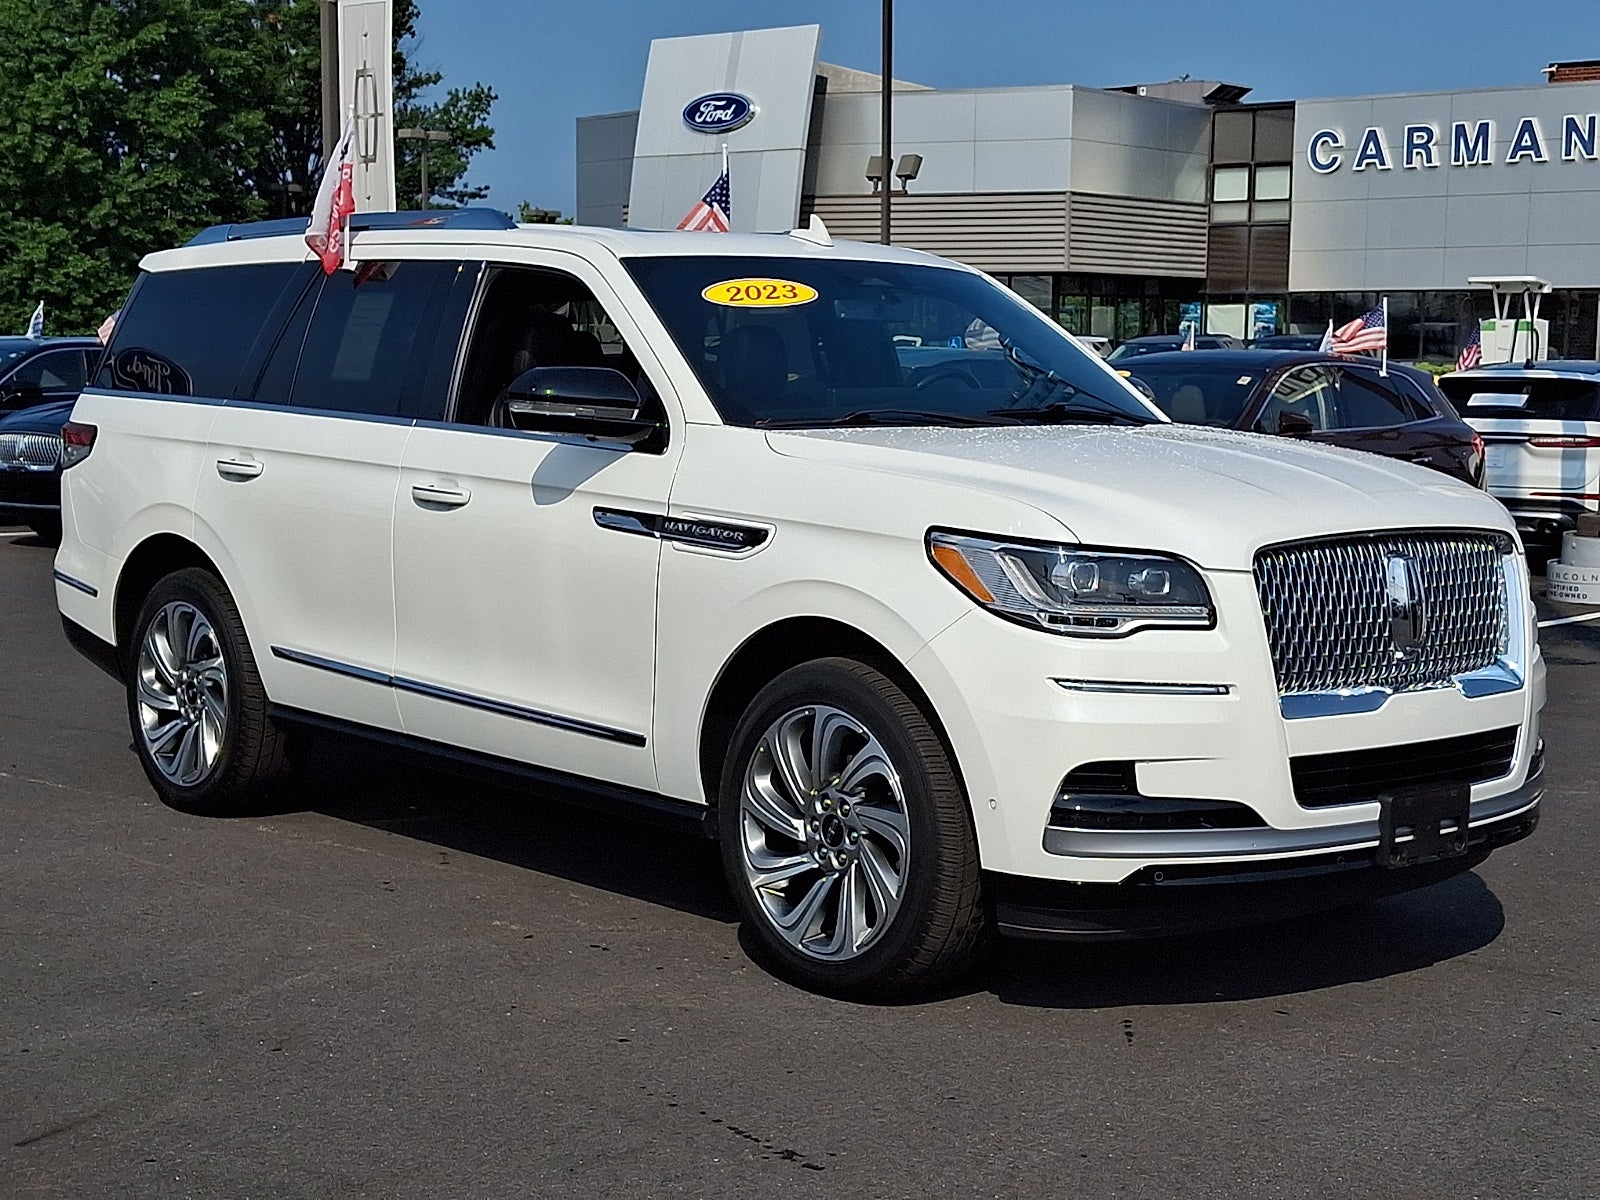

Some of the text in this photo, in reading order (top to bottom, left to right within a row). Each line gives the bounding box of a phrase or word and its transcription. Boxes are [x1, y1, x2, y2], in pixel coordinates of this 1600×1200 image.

[695, 100, 736, 122] Ford
[1308, 114, 1599, 174] CARMAN
[726, 284, 798, 302] 2023
[664, 521, 745, 541] NAVIGATOR
[1551, 572, 1599, 581] INCOLN
